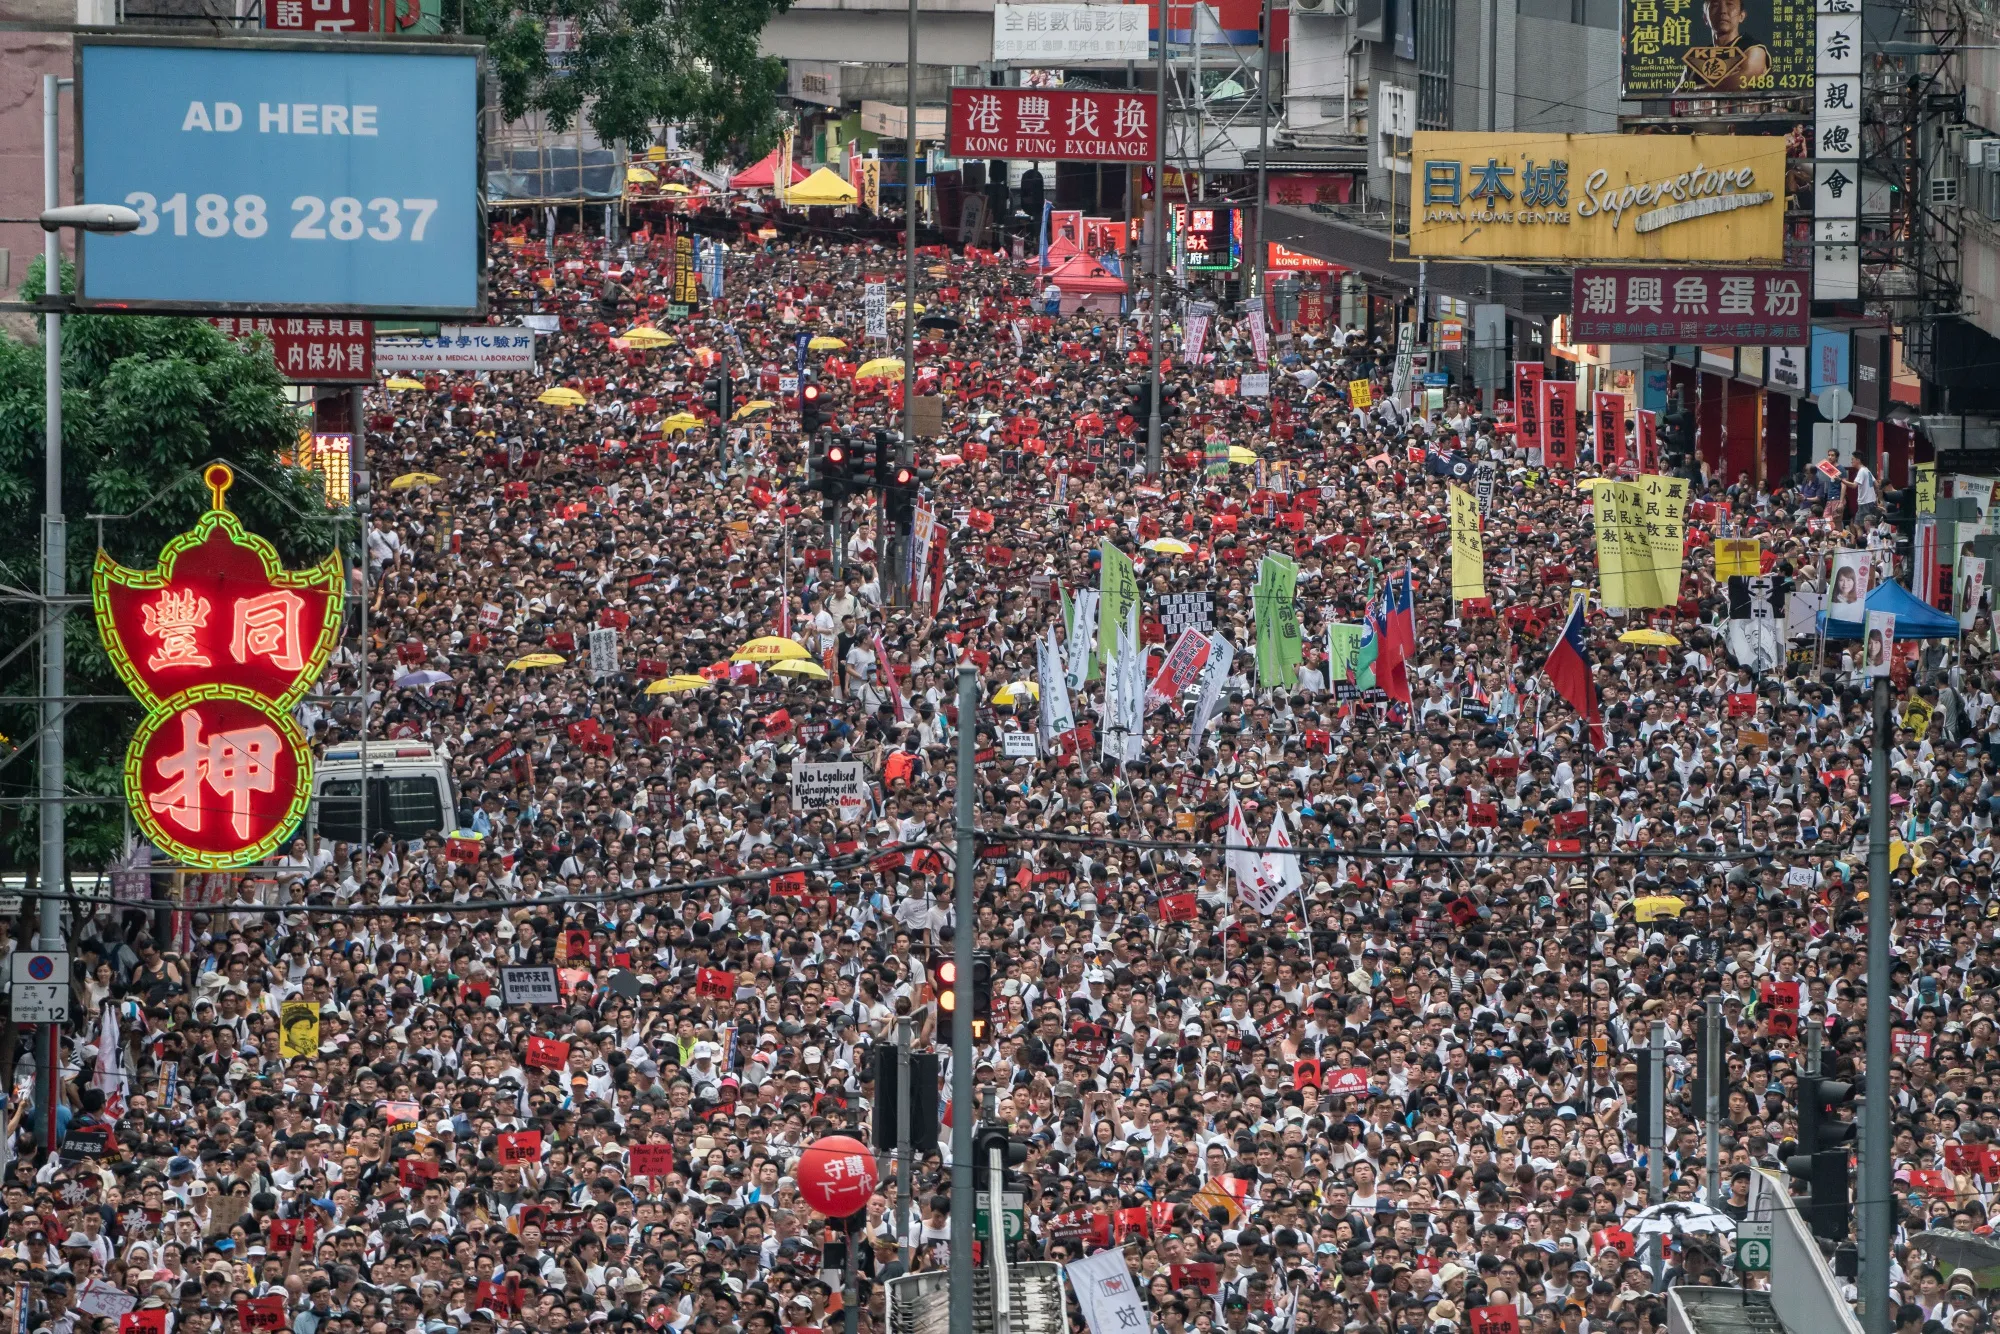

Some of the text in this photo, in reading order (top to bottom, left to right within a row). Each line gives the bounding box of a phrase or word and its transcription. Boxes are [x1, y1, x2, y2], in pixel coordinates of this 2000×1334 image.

[1004, 10, 1139, 33] 全能數碼影像
[1694, 48, 1735, 59] KF1
[1641, 57, 1675, 65] Fu Tak
[1632, 72, 1682, 80] Championships
[1739, 75, 1815, 90] 3488 4378
[1628, 81, 1697, 90] www.kf1-hk.com
[181, 101, 379, 137] AD HERE
[965, 136, 1149, 157] KONG FUNG EXCHANGE
[1423, 157, 1570, 209] 日本城
[1577, 162, 1756, 228] Superstore
[123, 191, 440, 242] 3188 2837
[1423, 210, 1571, 225] JAPAN HOME CENTRE
[1275, 257, 1300, 266] KONG
[1302, 258, 1324, 267] FUNG
[1580, 275, 1803, 318] 潮興魚蛋粉
[1578, 321, 1676, 340] 正宗潮州食品
[1703, 322, 1803, 341] 老火靚骨湯底
[445, 354, 478, 362] MEDICAL
[480, 354, 531, 362] LABORATORY
[1519, 379, 1537, 438] 反送中
[1550, 398, 1566, 458] 反送中
[368, 750, 388, 758] POLICE
[149, 708, 282, 841] 押
[800, 768, 856, 783] No Legalised
[795, 782, 858, 798] Kidnapping of HK
[801, 795, 862, 810] People to China
[449, 849, 474, 860] 反送中
[1790, 872, 1813, 884] 反送中
[775, 880, 801, 892] 反送中
[508, 971, 550, 983] 我們不天真
[21, 986, 58, 999] 上午 7
[701, 981, 728, 996] 反送中
[1767, 993, 1794, 1006] 反送中
[14, 1005, 45, 1014] midnight
[48, 1007, 65, 1021] 12
[531, 1050, 560, 1062] No China
[505, 1147, 535, 1160] 反送中
[633, 1146, 671, 1155] Hong Kong
[823, 1154, 866, 1181] 守護
[816, 1173, 875, 1202] 下一代
[276, 1234, 308, 1247] 反送中
[245, 1314, 279, 1327] 反送中
[1478, 1318, 1513, 1334] 反送中
